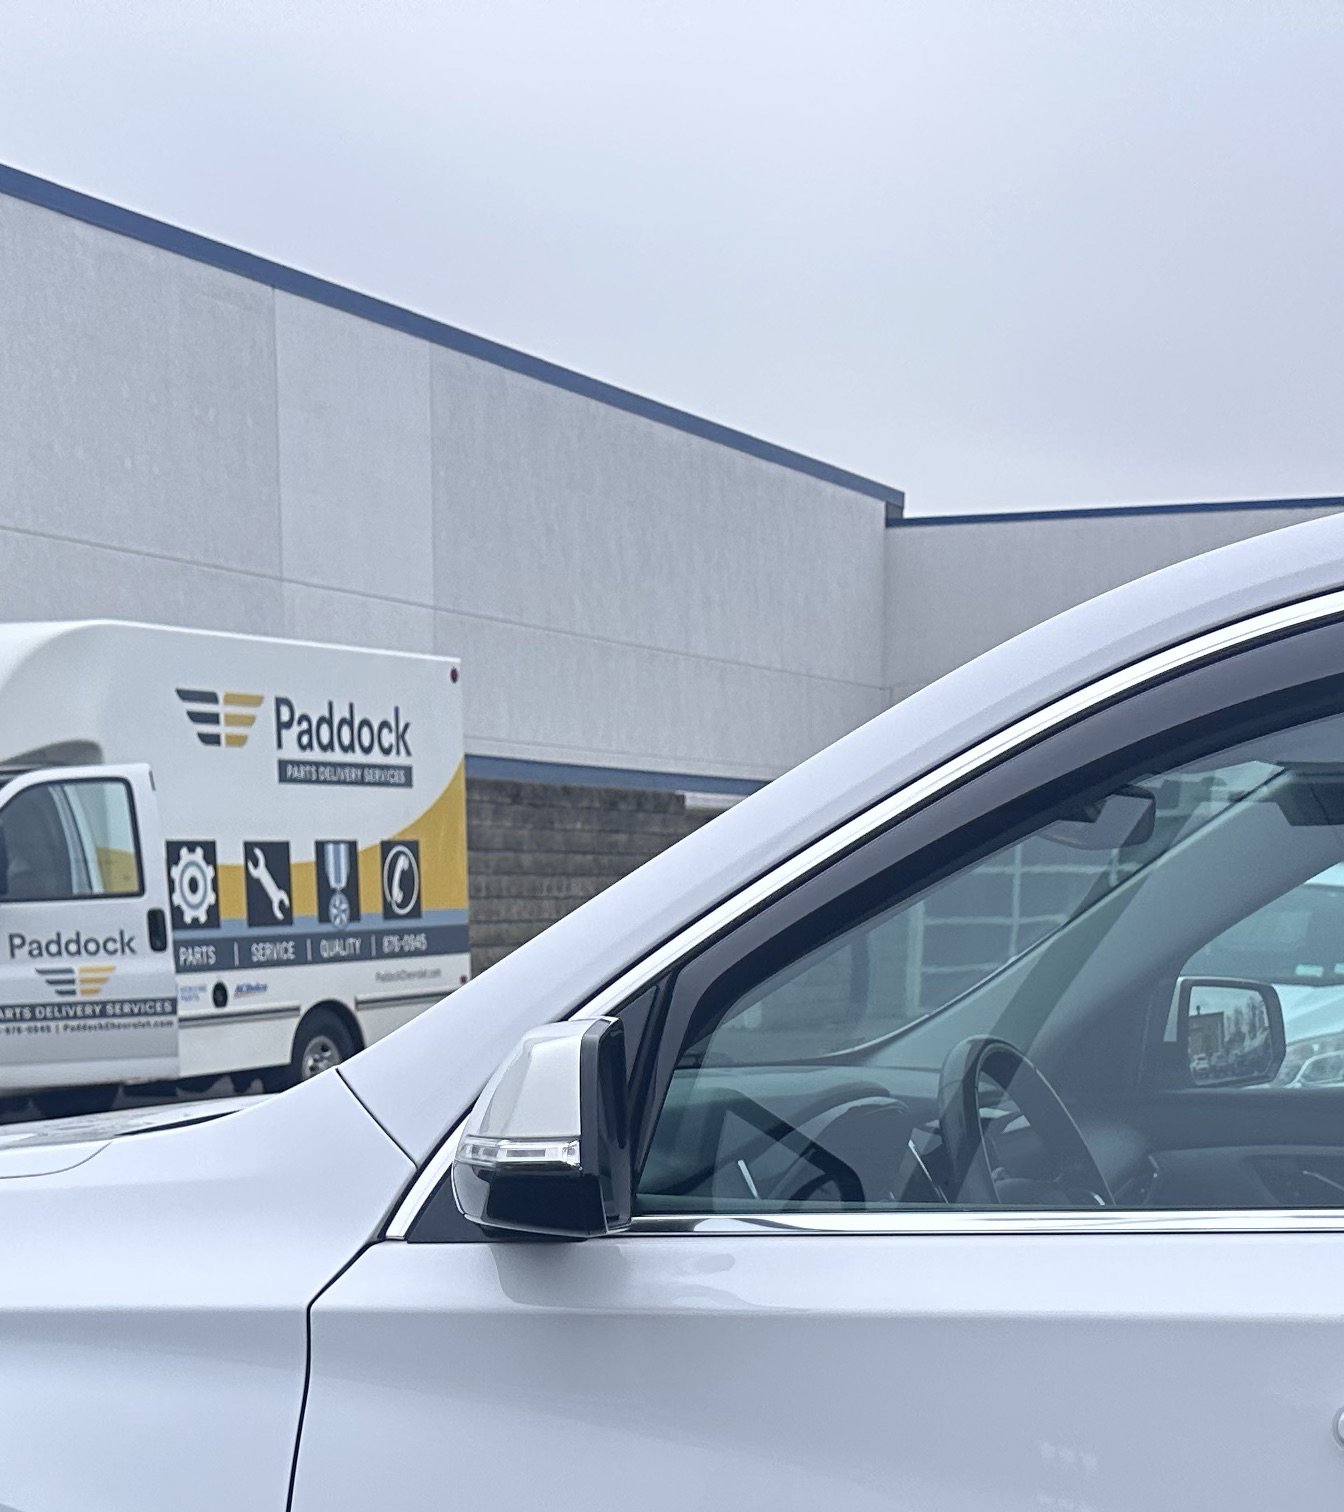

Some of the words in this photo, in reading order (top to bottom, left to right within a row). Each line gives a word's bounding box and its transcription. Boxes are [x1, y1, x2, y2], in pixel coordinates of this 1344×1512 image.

[274, 696, 412, 757] Paddock
[286, 763, 317, 780] PARTS
[319, 765, 363, 782] DELIVERY
[364, 768, 406, 784] SERVICES
[8, 928, 137, 959] Paddock
[179, 945, 216, 967] PARTS
[251, 941, 295, 961] SERVICE
[320, 938, 361, 958] QUALITY
[35, 1004, 103, 1019] DELIVERY
[106, 1000, 173, 1016] SERVICES
